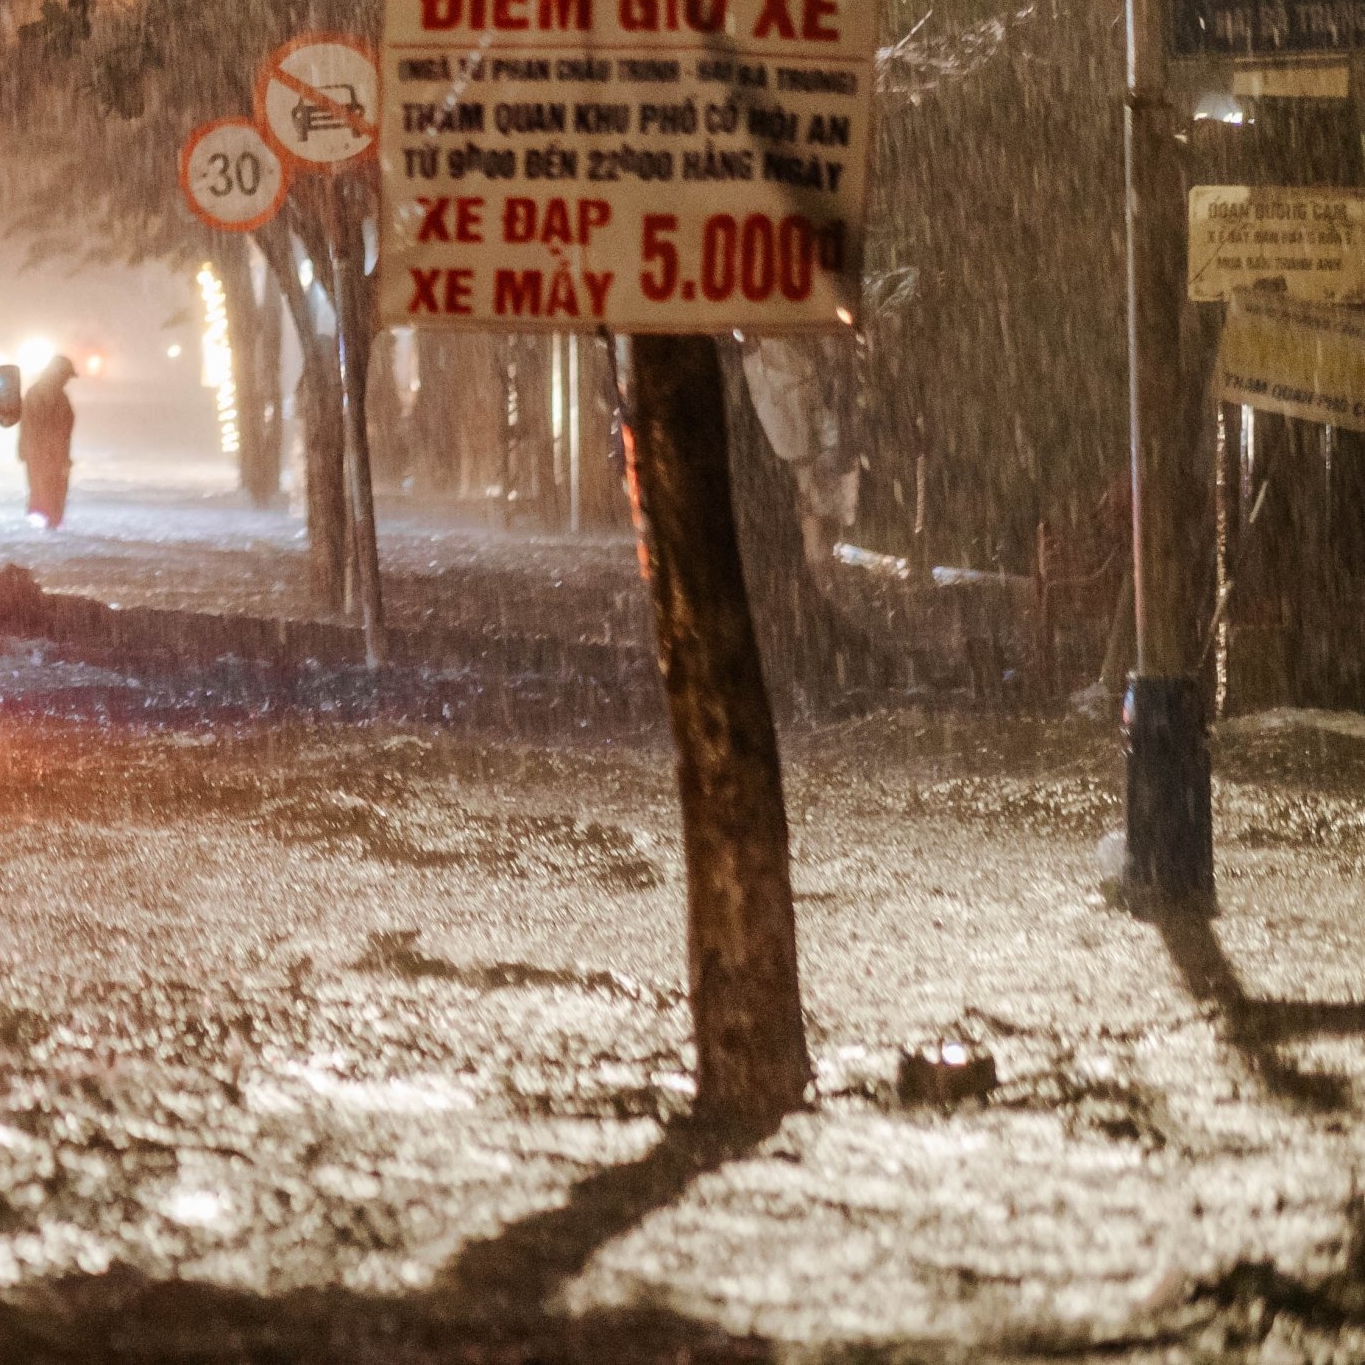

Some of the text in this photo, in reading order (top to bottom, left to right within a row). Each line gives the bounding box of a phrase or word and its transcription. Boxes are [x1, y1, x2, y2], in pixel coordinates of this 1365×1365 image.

[491, 58, 550, 82] PHAN
[403, 102, 485, 133] THAM
[495, 102, 566, 137] QUAN
[574, 102, 630, 134] KHU
[807, 114, 850, 147] AN
[207, 152, 261, 197] 30
[416, 197, 612, 256] XE ĐẠP
[408, 260, 614, 317] XE MÁY
